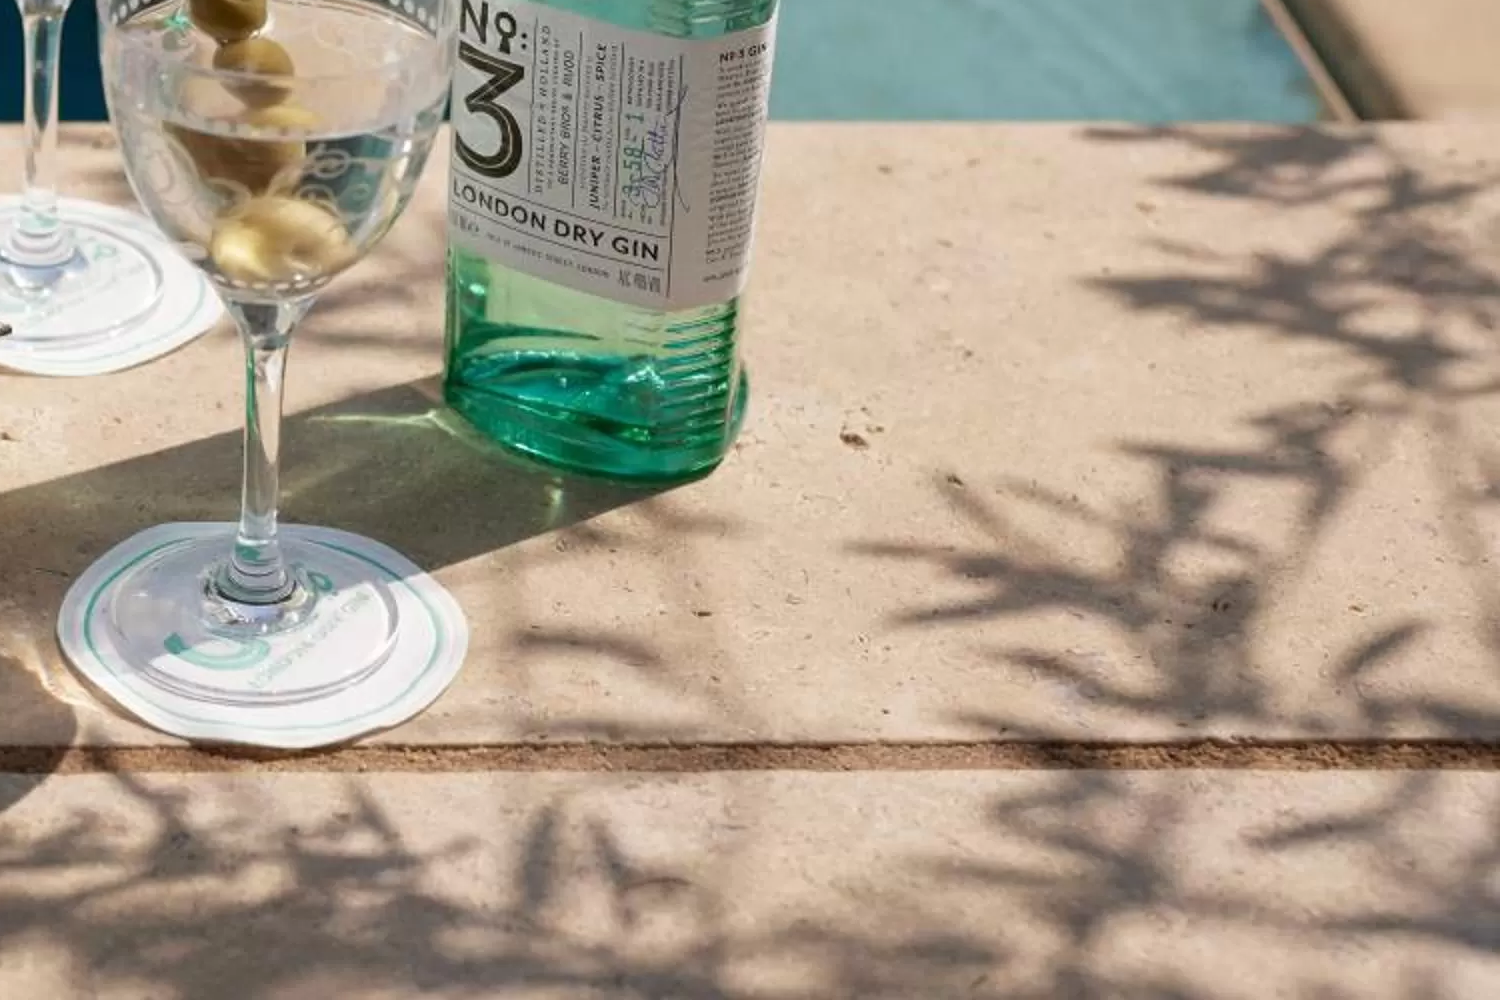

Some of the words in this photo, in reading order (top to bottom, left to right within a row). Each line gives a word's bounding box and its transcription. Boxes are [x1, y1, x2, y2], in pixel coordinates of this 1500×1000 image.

[595, 43, 607, 82] SPICE
[454, 40, 526, 179] 3
[591, 95, 605, 143] CITRUS
[589, 155, 602, 212] JUNIPER
[453, 176, 547, 232] LONDON
[553, 219, 605, 247] DRY
[611, 235, 660, 262] GIN
